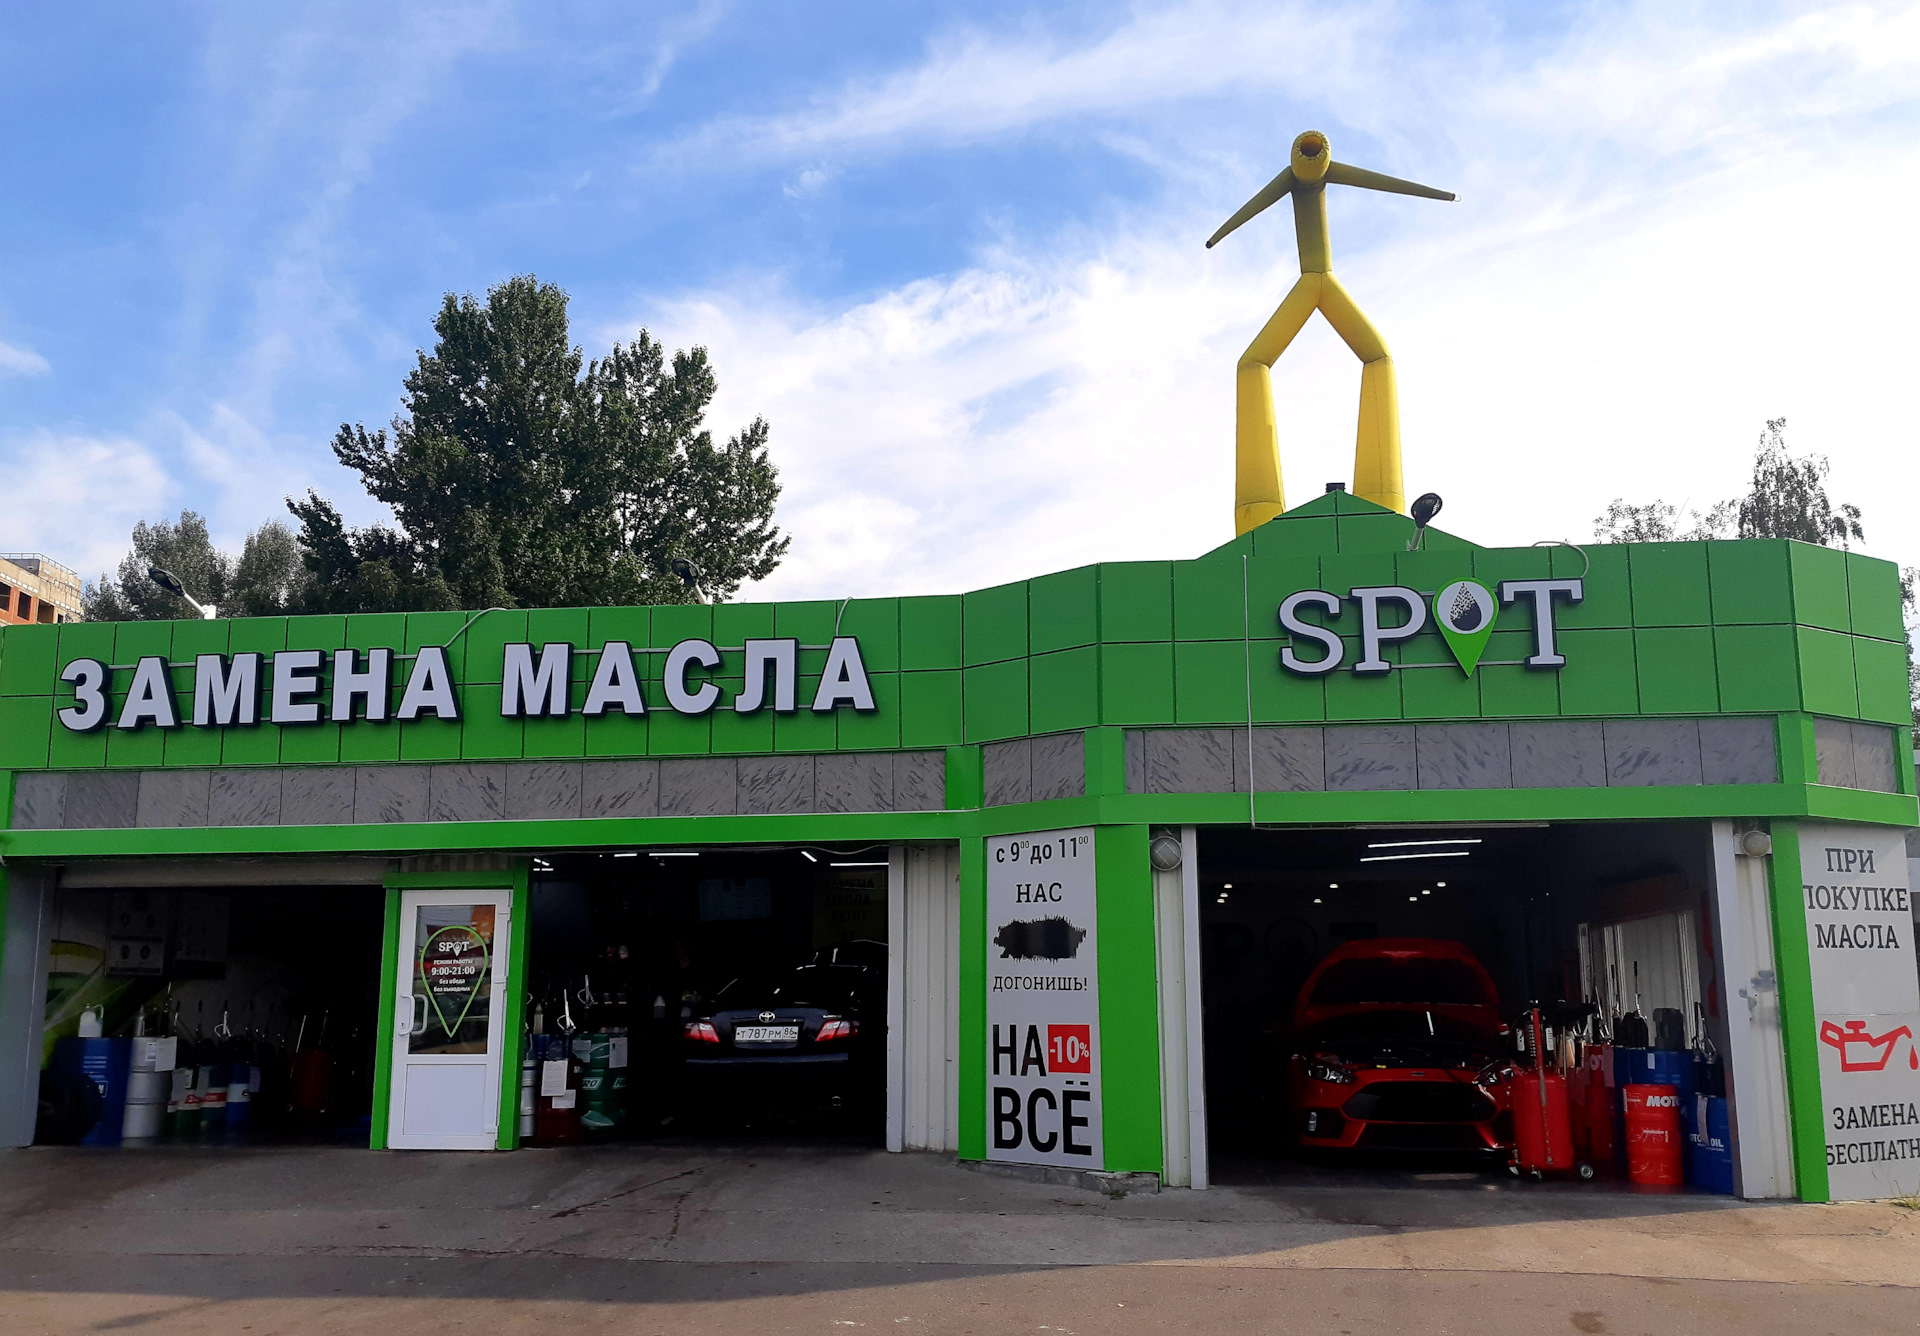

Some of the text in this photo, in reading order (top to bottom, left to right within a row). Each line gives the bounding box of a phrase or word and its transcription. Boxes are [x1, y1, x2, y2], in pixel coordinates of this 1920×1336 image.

[57, 636, 879, 732] ЗАМЕНА МАСЛА
[1030, 844, 1052, 865] до
[1825, 848, 1876, 873] ПРИ
[1016, 882, 1062, 903] НАС
[1815, 924, 1900, 949] МАСЛА
[431, 966, 475, 976] 9:00-21:00
[993, 976, 1087, 992] ДОГОНИШЬ!
[992, 1024, 1089, 1076] НА -10%
[993, 1080, 1092, 1156] ВСЁ
[1833, 1103, 1919, 1130] ЗАМЕНА
